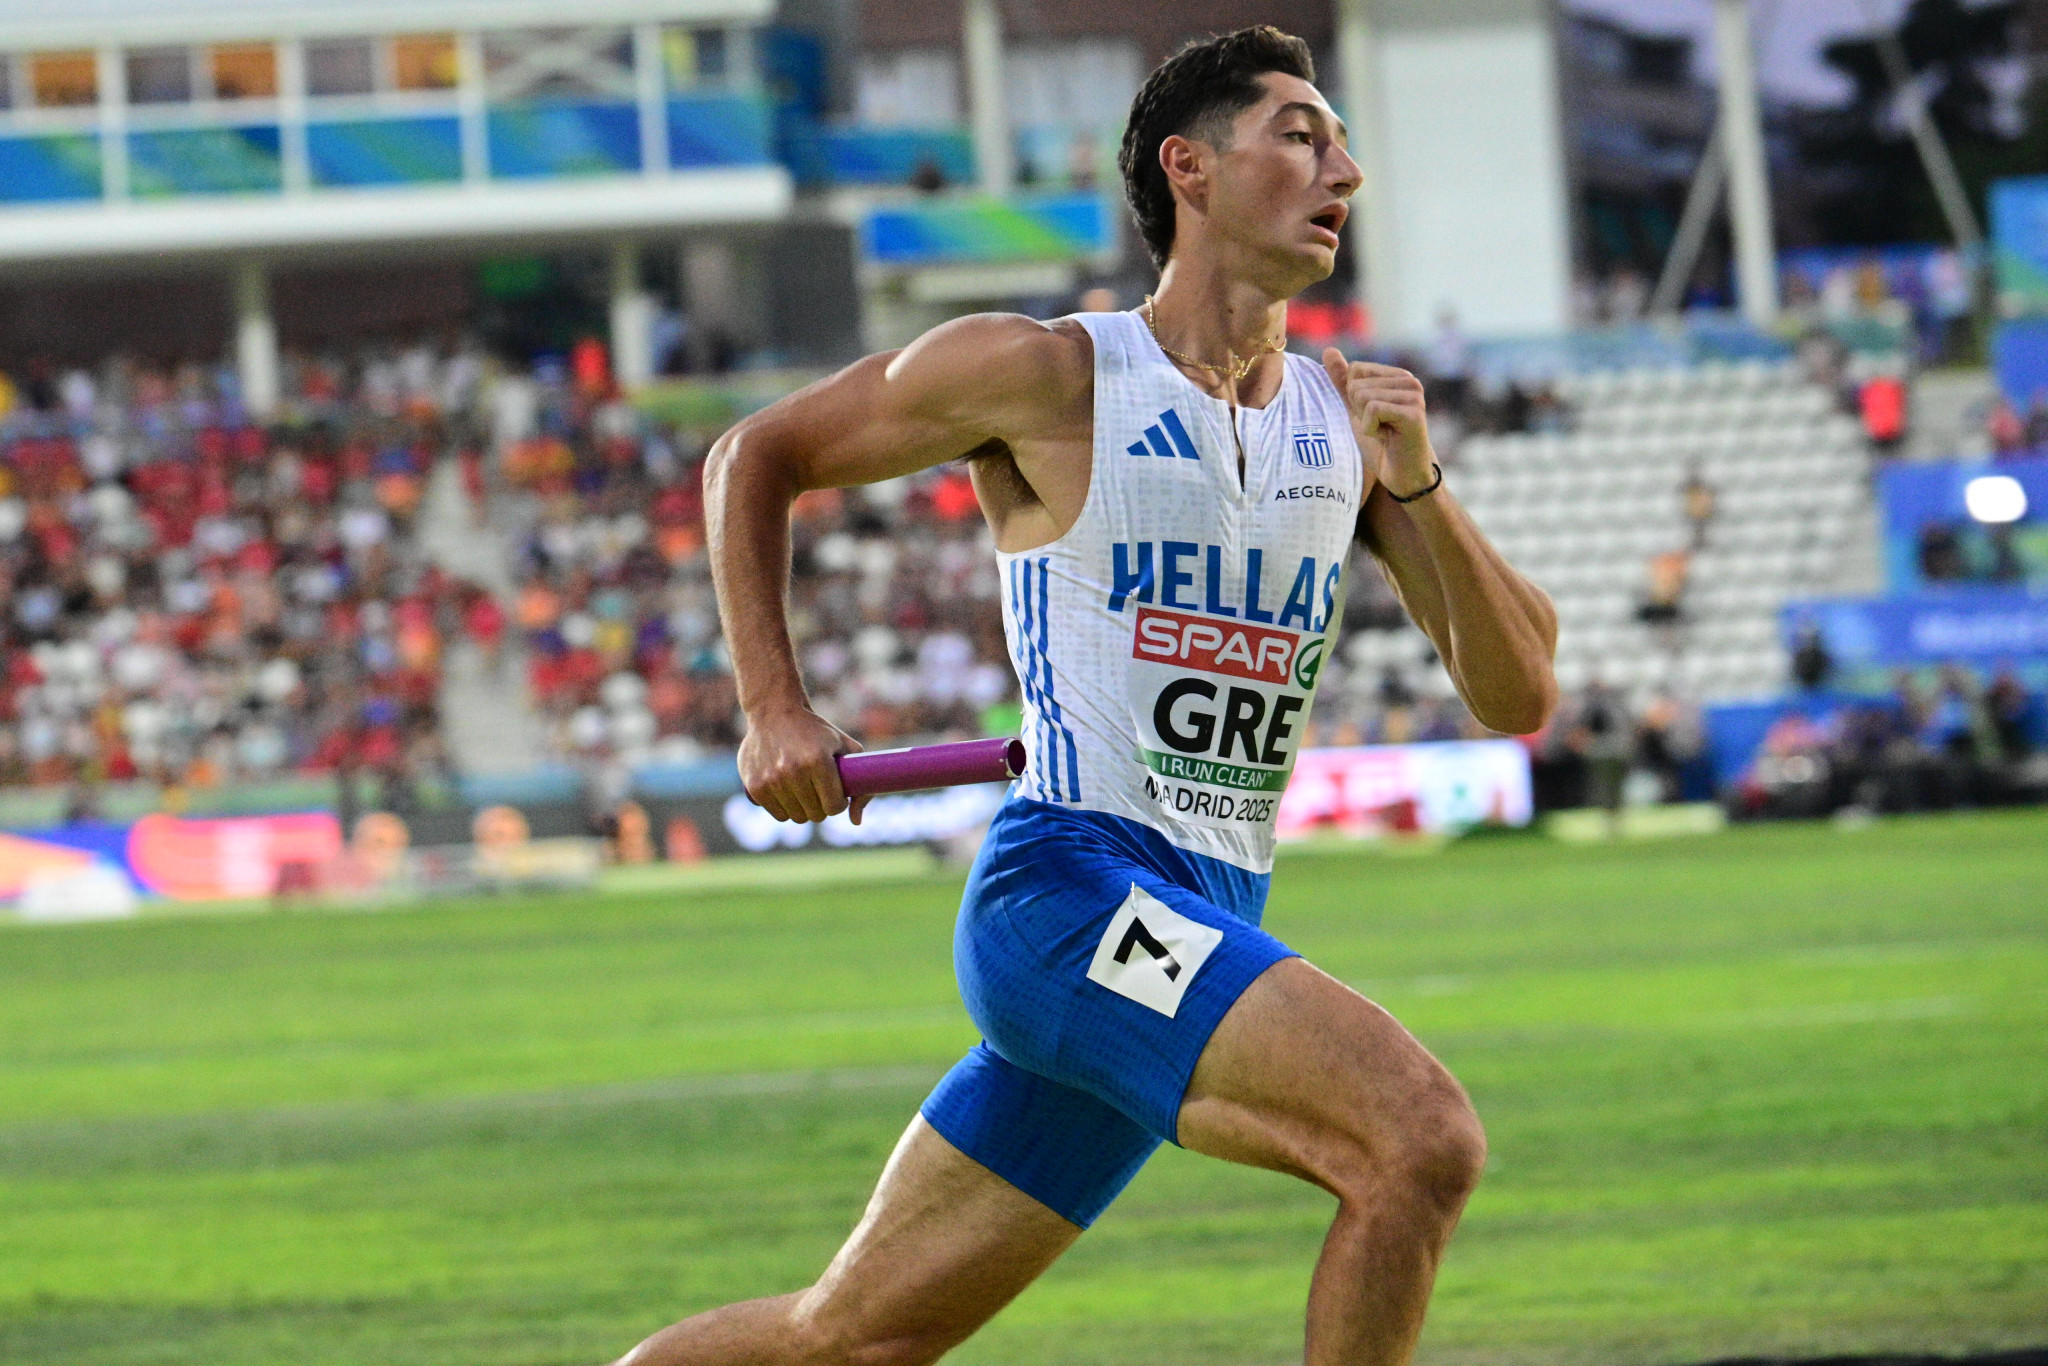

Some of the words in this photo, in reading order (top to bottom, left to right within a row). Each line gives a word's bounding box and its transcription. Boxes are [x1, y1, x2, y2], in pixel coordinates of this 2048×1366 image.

[1275, 485, 1346, 504] AEGEAN
[1107, 541, 1340, 633] HELLAS
[1139, 616, 1294, 678] SPAR
[1153, 677, 1304, 766] GRE
[1145, 775, 1235, 819] MADRID
[1235, 799, 1275, 822] 2025
[1161, 756, 1167, 772] I
[1171, 757, 1215, 781] RUN
[1113, 916, 1182, 983] 7
